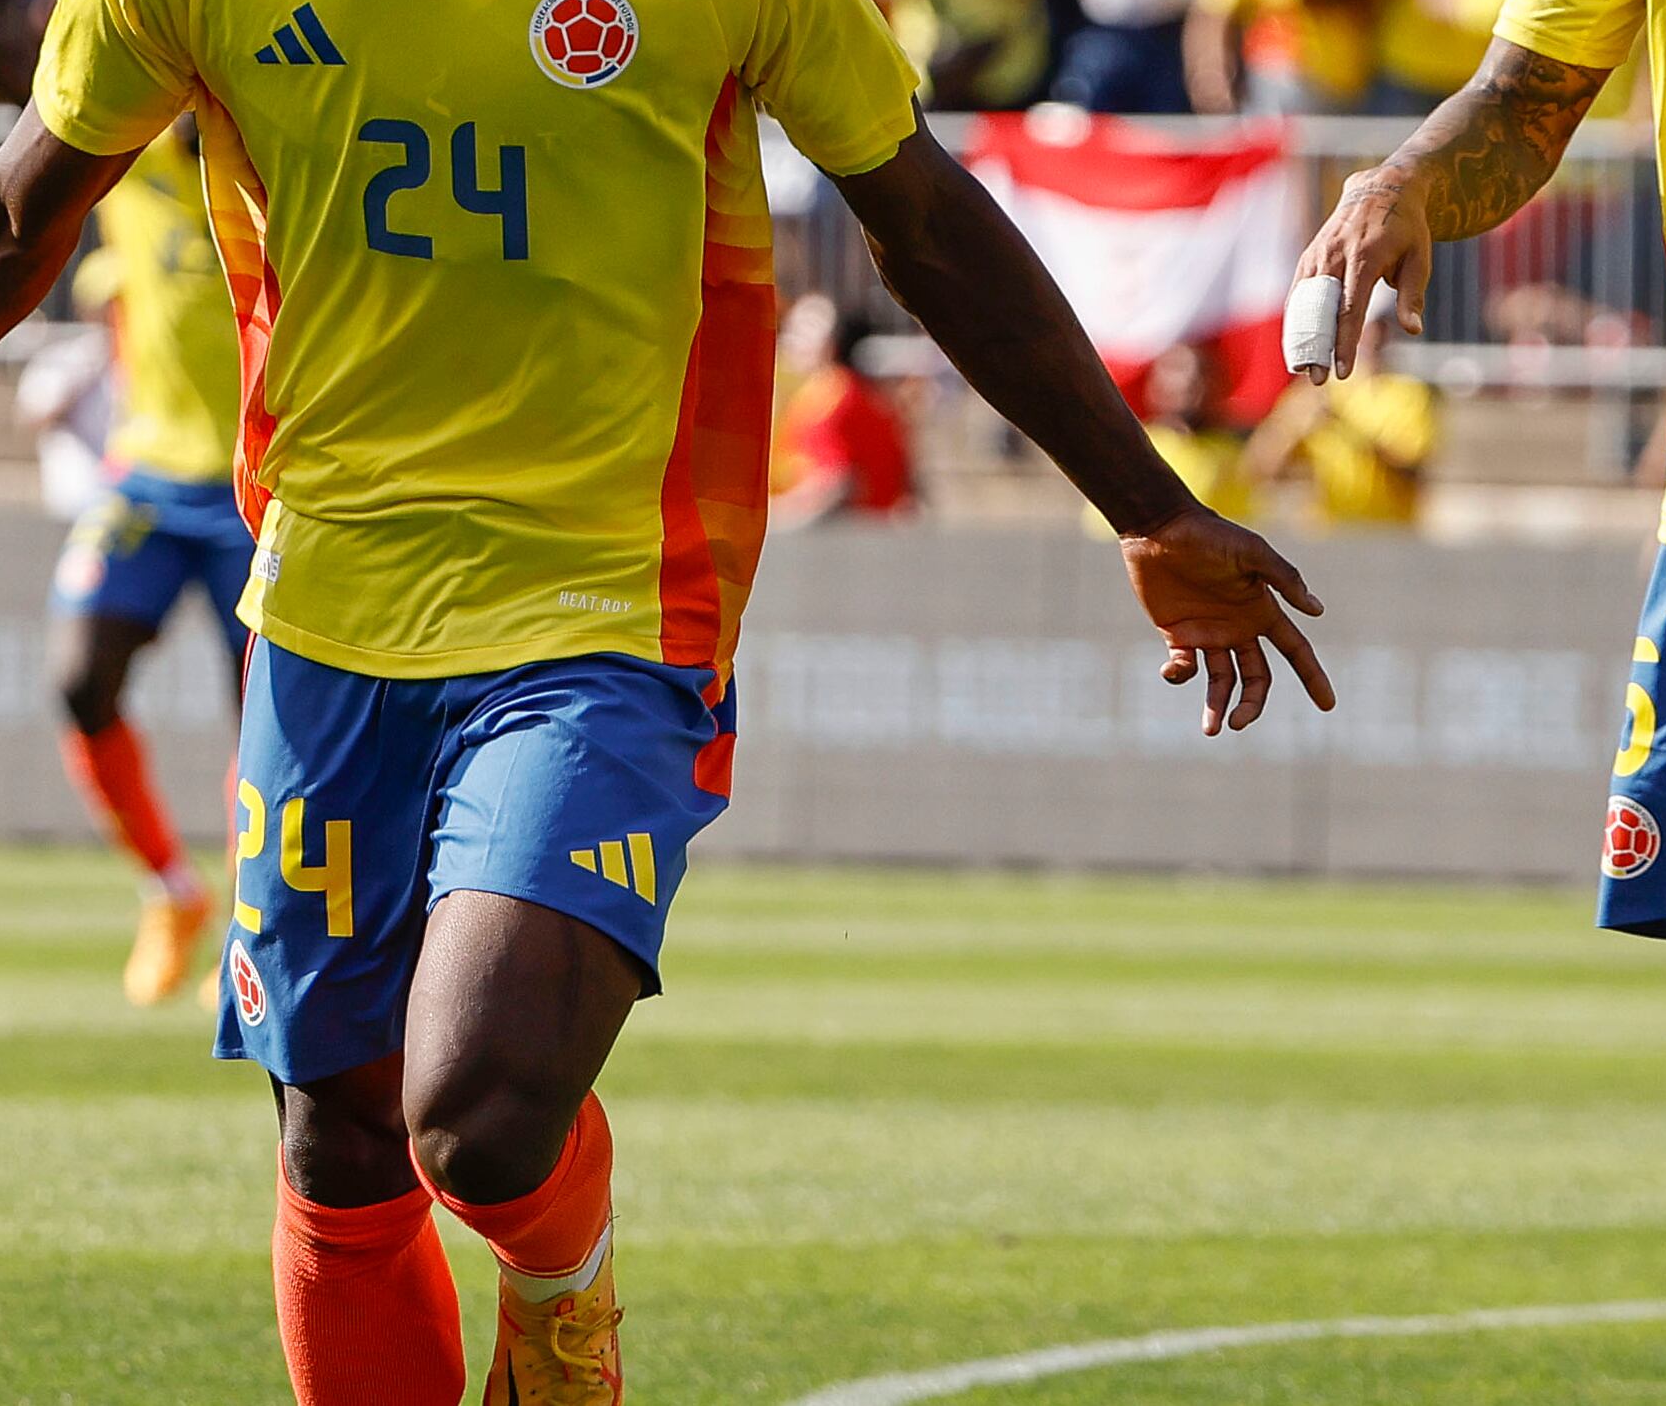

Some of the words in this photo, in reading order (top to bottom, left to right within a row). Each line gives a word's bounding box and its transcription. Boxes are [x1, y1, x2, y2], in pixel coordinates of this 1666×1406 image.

[358, 118, 529, 261] 24
[558, 590, 632, 613] HEAT.RDY
[234, 778, 354, 937] 24
